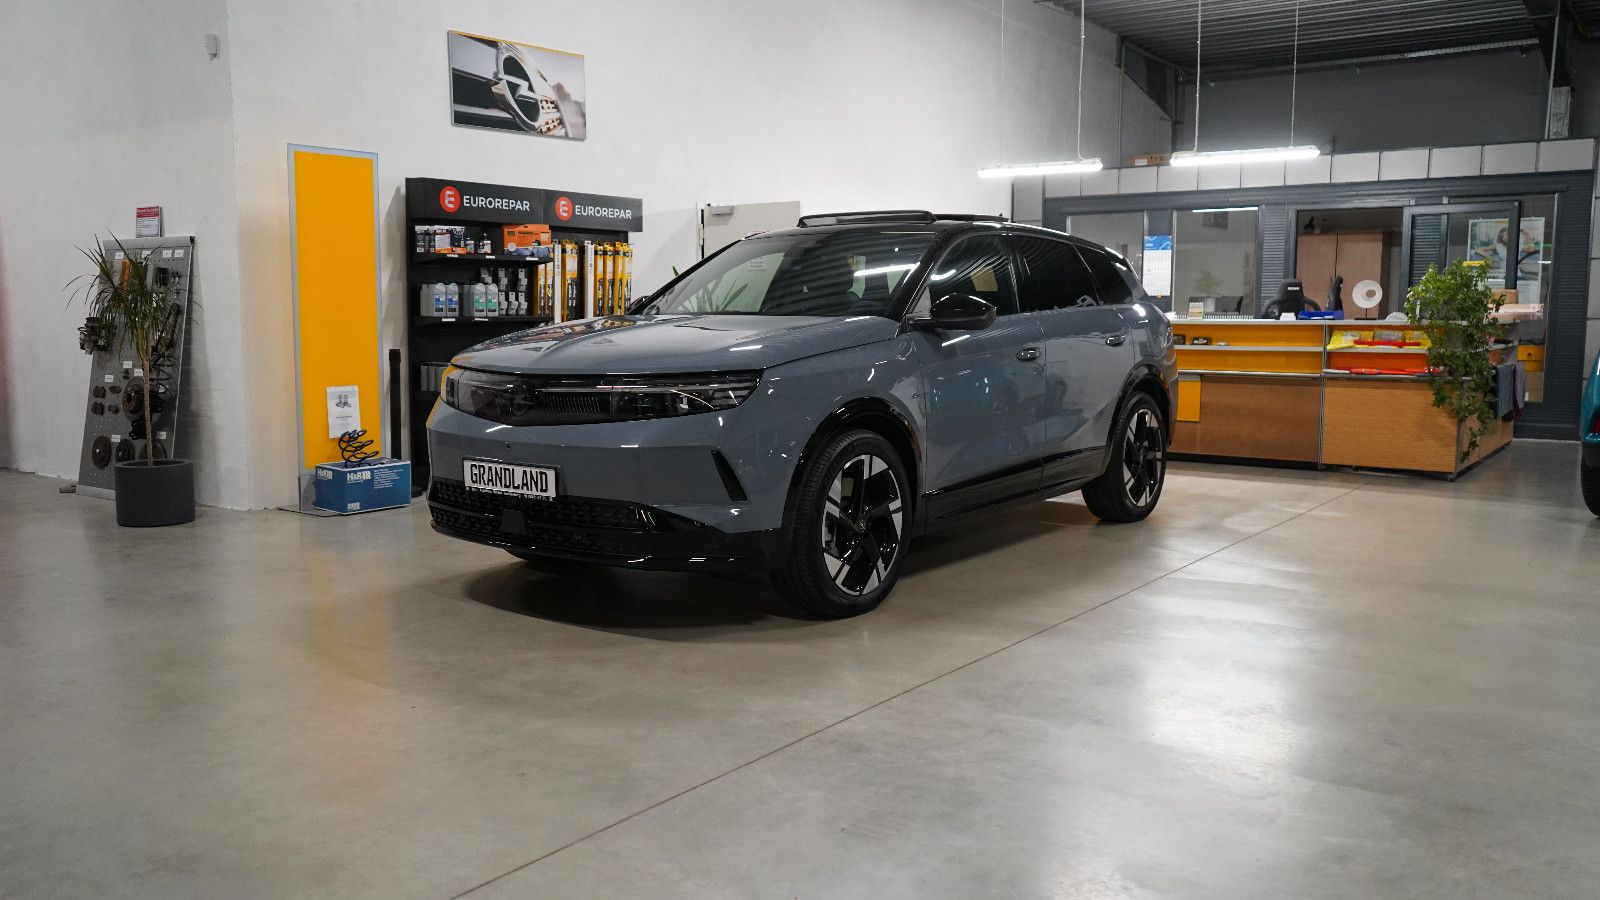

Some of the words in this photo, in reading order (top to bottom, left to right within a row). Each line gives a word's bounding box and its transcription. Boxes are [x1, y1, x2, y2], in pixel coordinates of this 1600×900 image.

[463, 195, 530, 211] EUROREPAR
[575, 205, 632, 219] EUROREPAR
[470, 463, 549, 493] GRANDLAND
